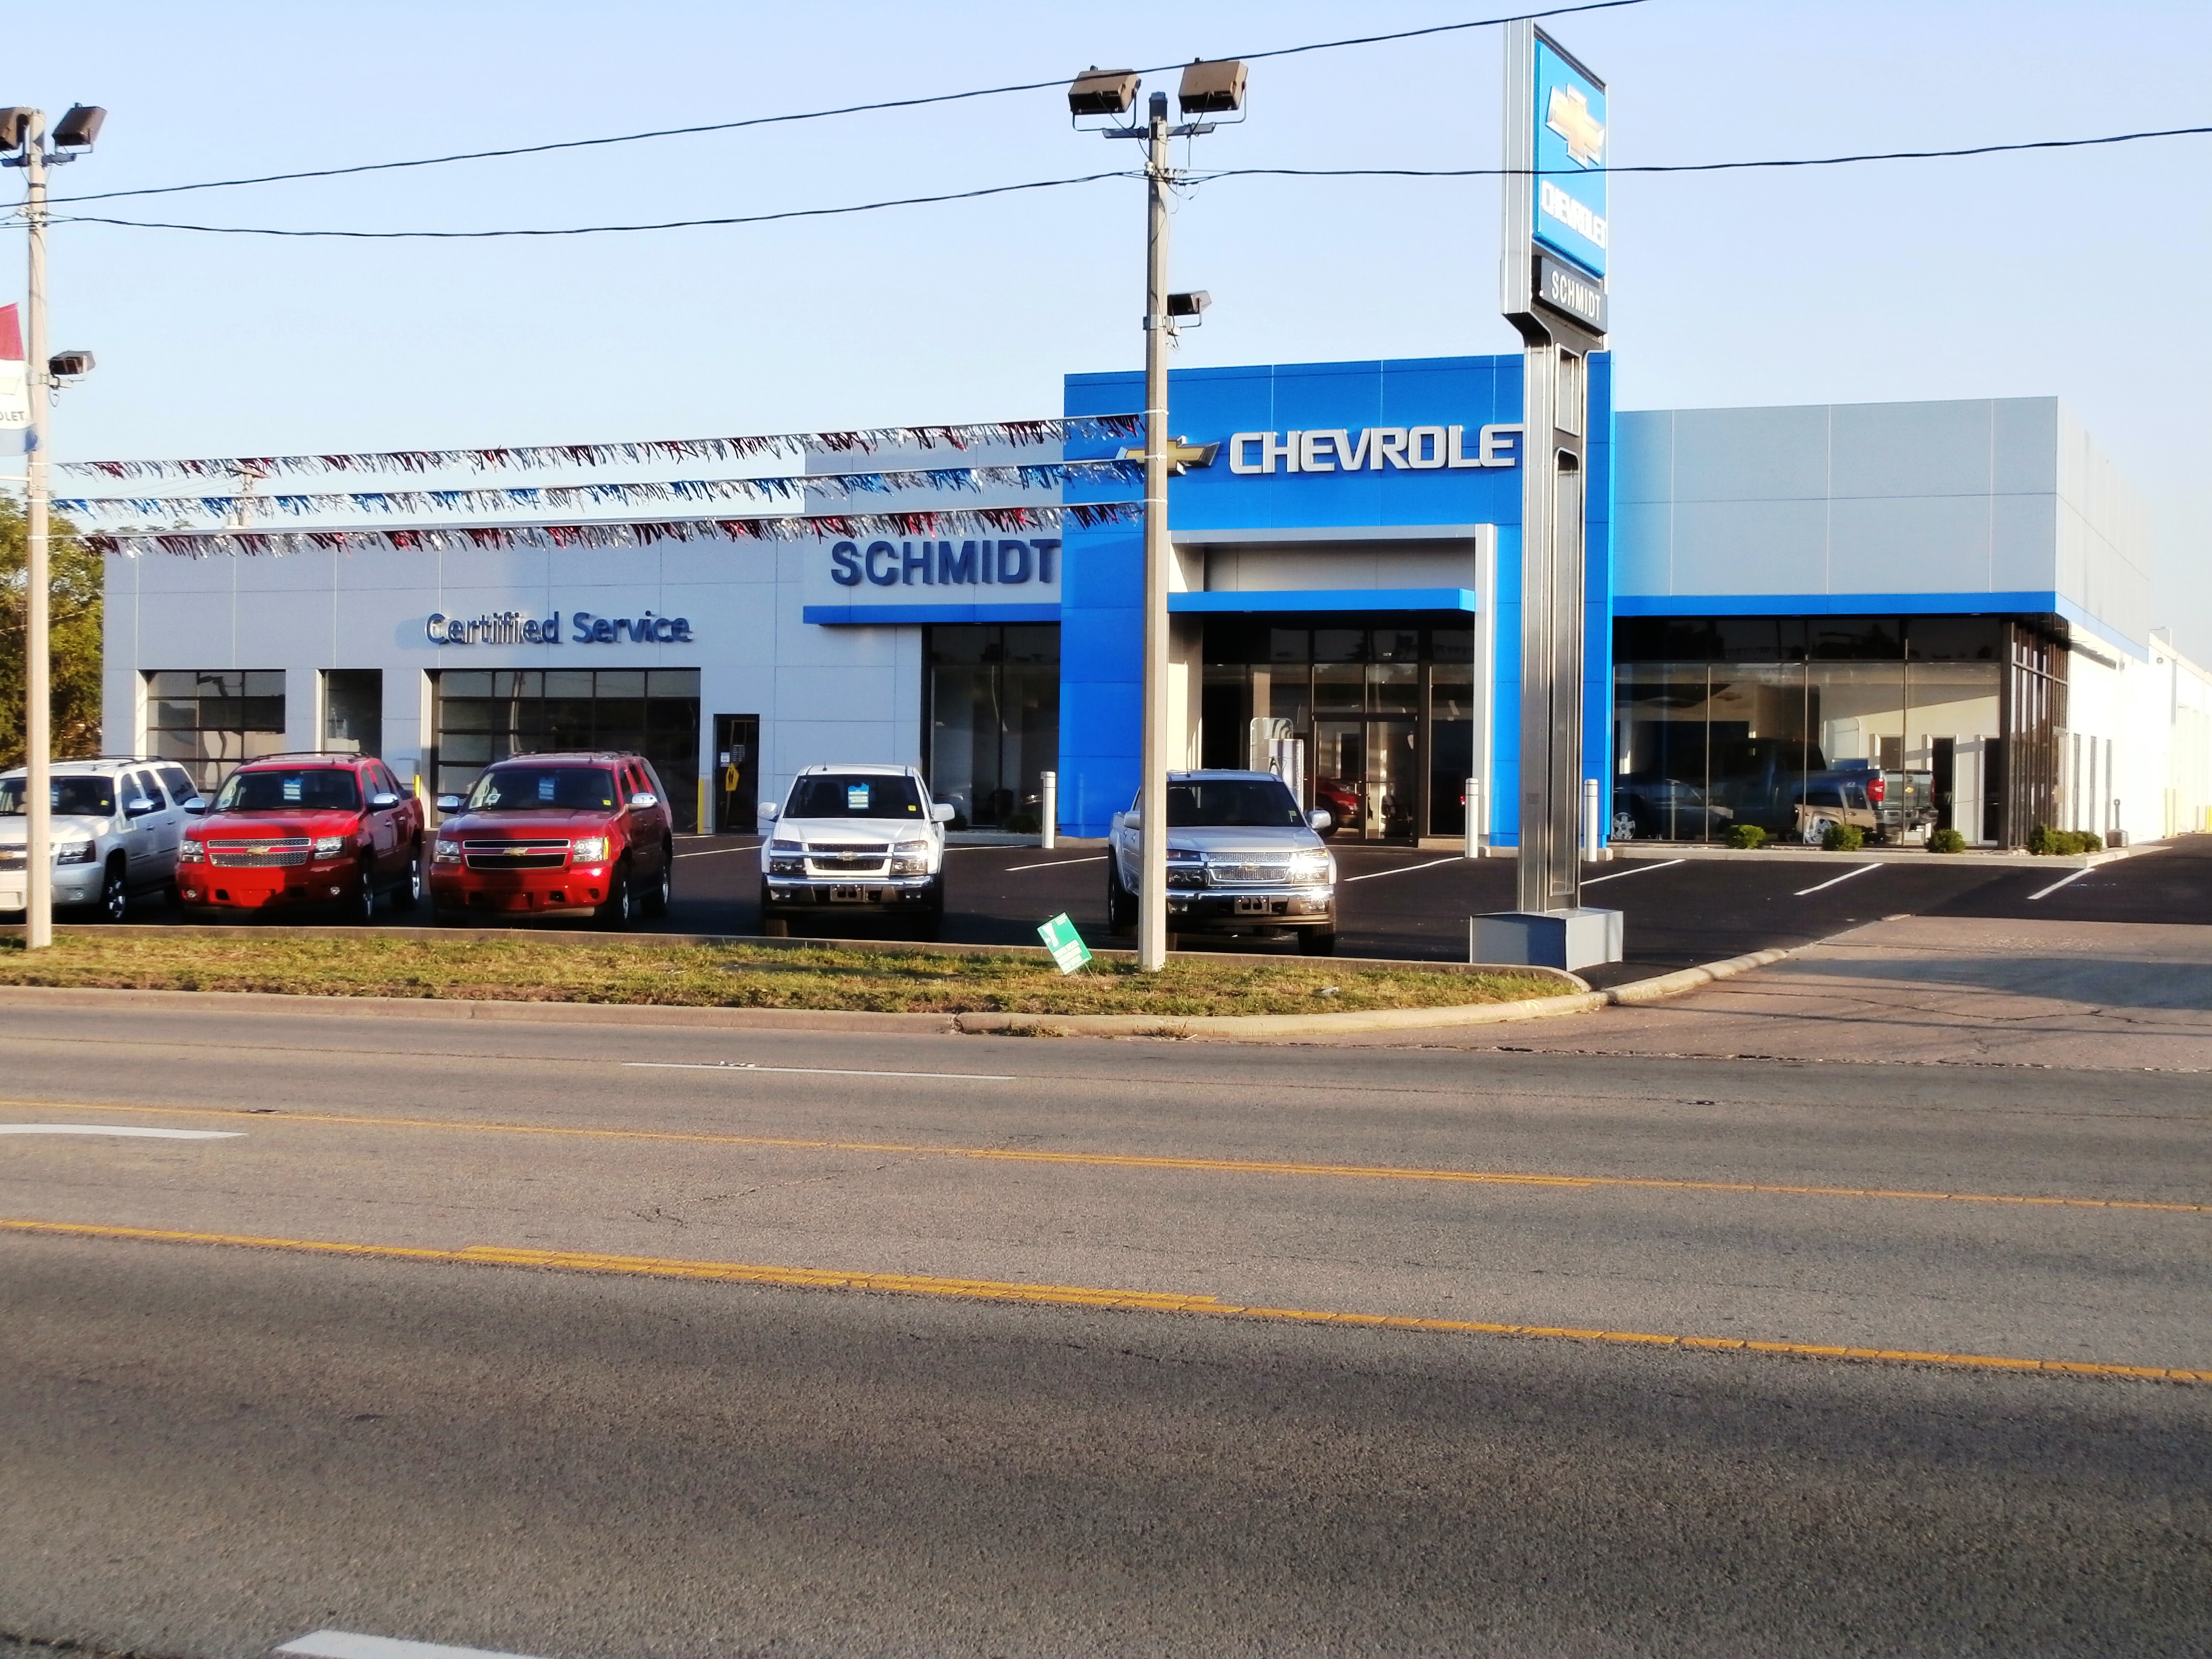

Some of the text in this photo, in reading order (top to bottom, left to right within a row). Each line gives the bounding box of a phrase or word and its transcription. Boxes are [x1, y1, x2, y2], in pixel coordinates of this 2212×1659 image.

[1540, 180, 1606, 249] CHEVROLET
[1551, 270, 1601, 321] SCHMIDT
[1229, 423, 1523, 474] CHEVROLE
[831, 539, 1063, 586] SCHMIDT
[424, 610, 693, 645] Certified Service
